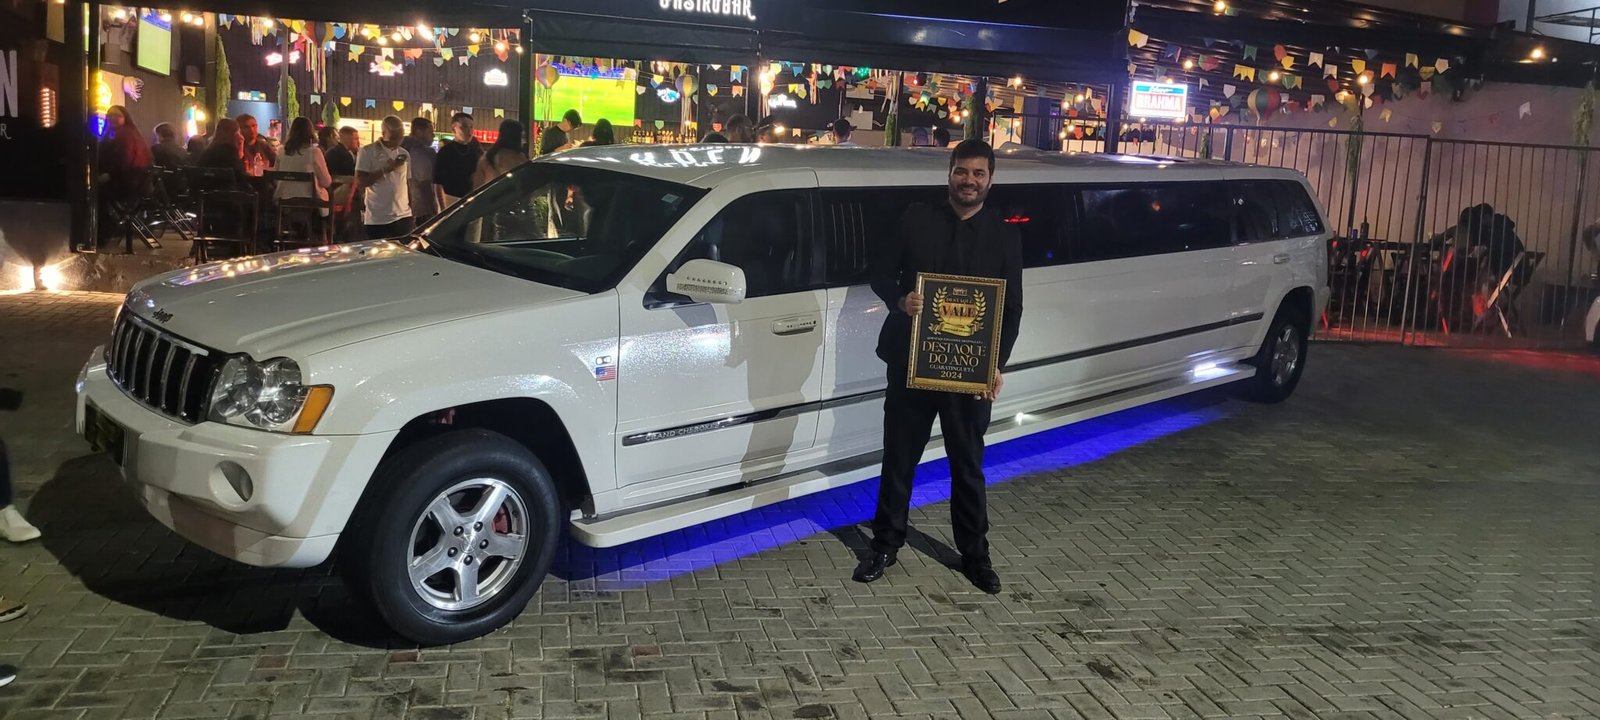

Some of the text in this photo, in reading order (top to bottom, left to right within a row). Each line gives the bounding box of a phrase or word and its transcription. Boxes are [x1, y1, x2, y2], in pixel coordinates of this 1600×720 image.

[1134, 93, 1183, 111] BRAHMA
[942, 304, 977, 318] VALE
[922, 340, 986, 357] DESTAQUE
[928, 352, 979, 367] DO ANO
[940, 371, 962, 379] 2024
[645, 430, 676, 441] GRAND
